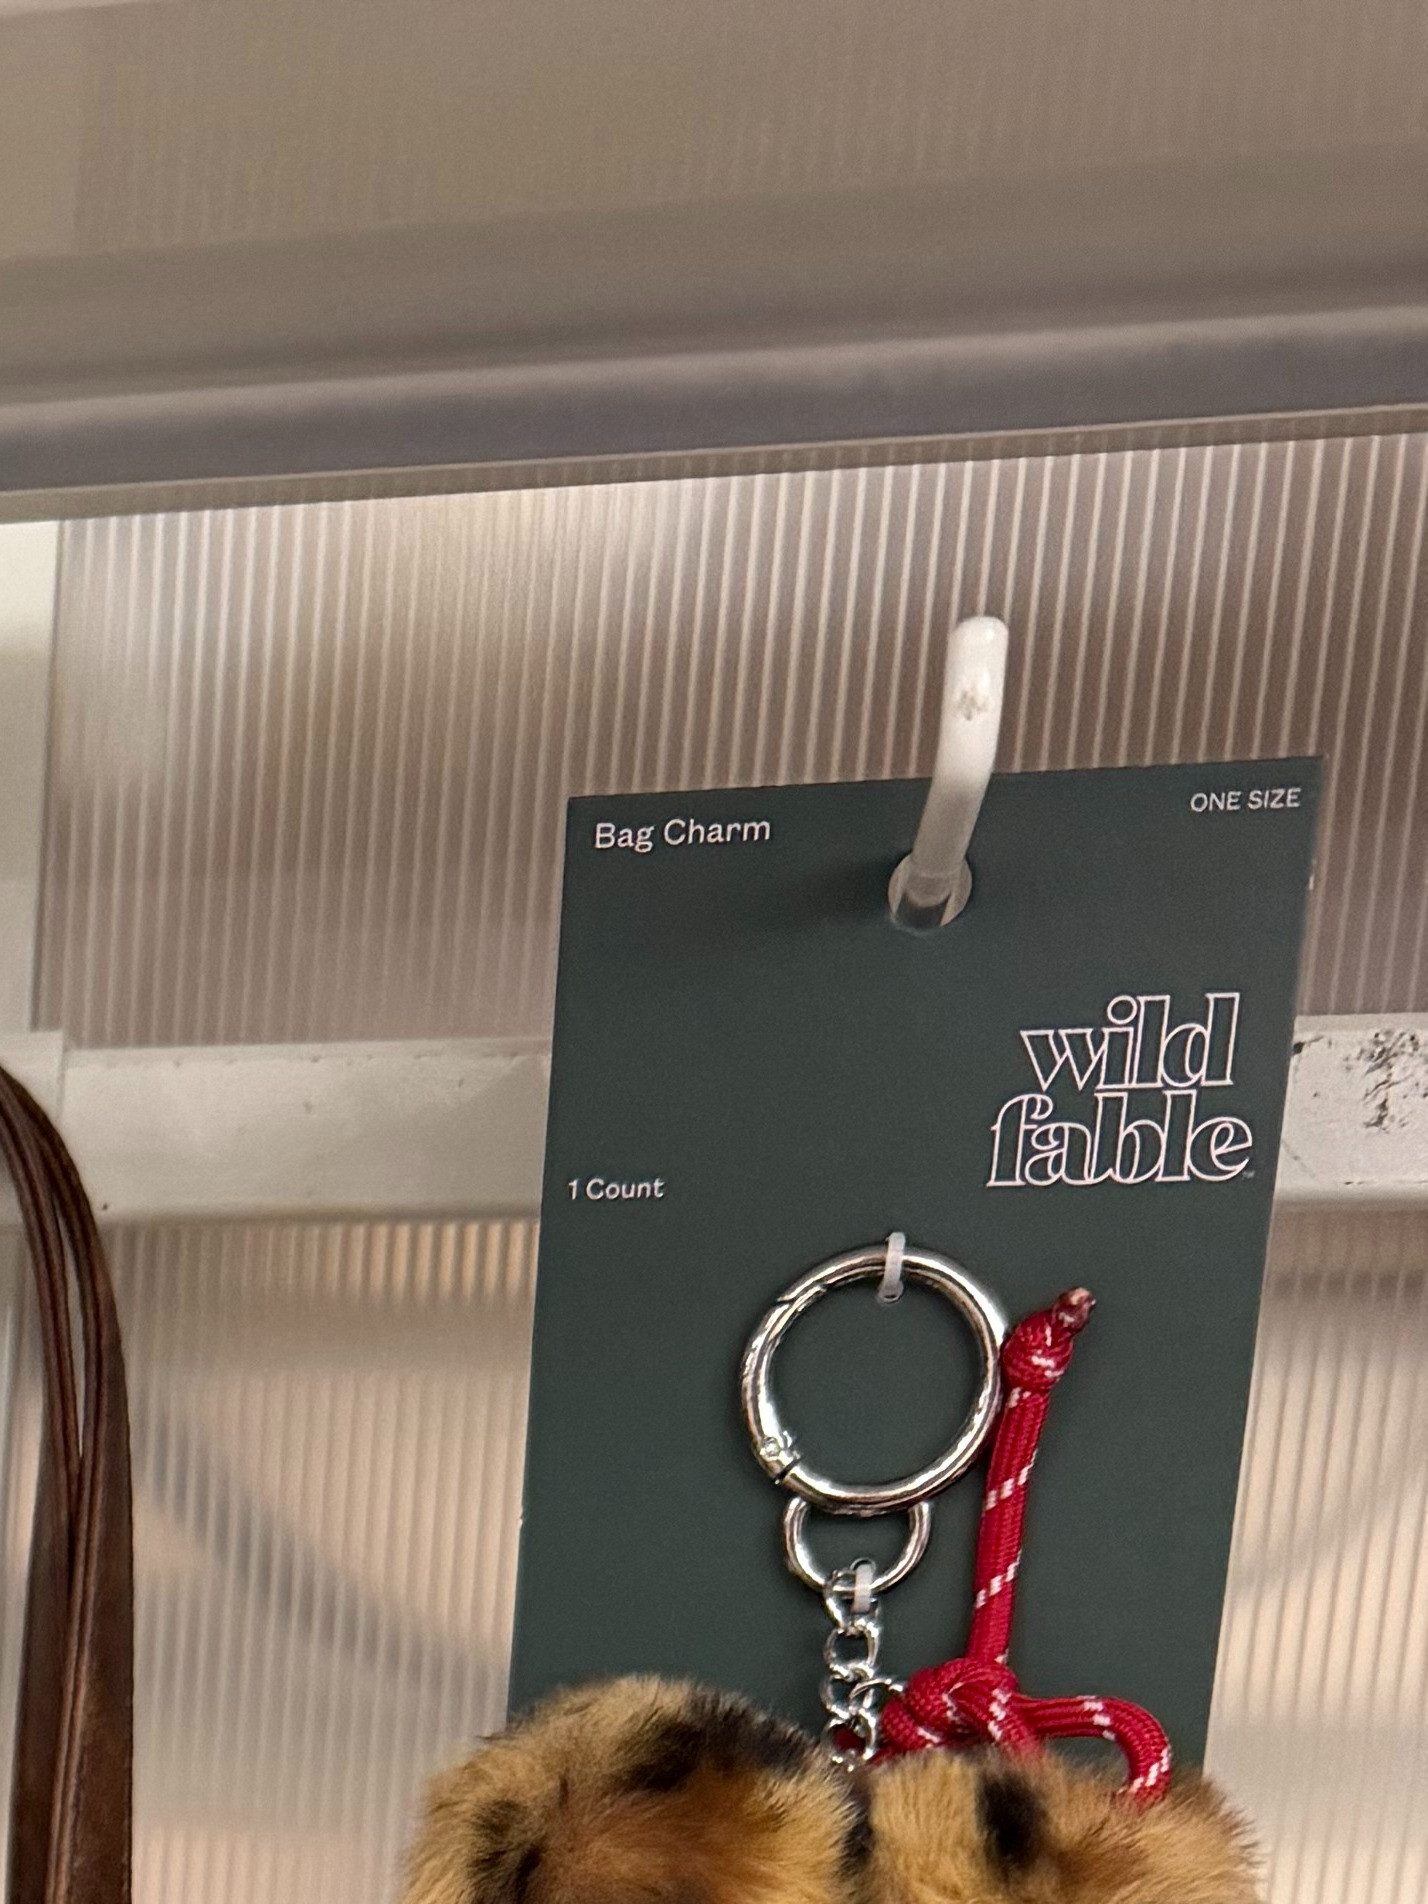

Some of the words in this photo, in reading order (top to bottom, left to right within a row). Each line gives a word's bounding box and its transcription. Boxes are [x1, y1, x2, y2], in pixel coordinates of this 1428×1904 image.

[1189, 790, 1243, 813] ONE
[1246, 786, 1303, 811] SIZE
[593, 821, 656, 854] Bag
[662, 816, 773, 847] Charm
[1018, 991, 1242, 1092] wild
[985, 1088, 1254, 1188] fable
[567, 1177, 580, 1202] 1
[584, 1176, 666, 1202] Count
